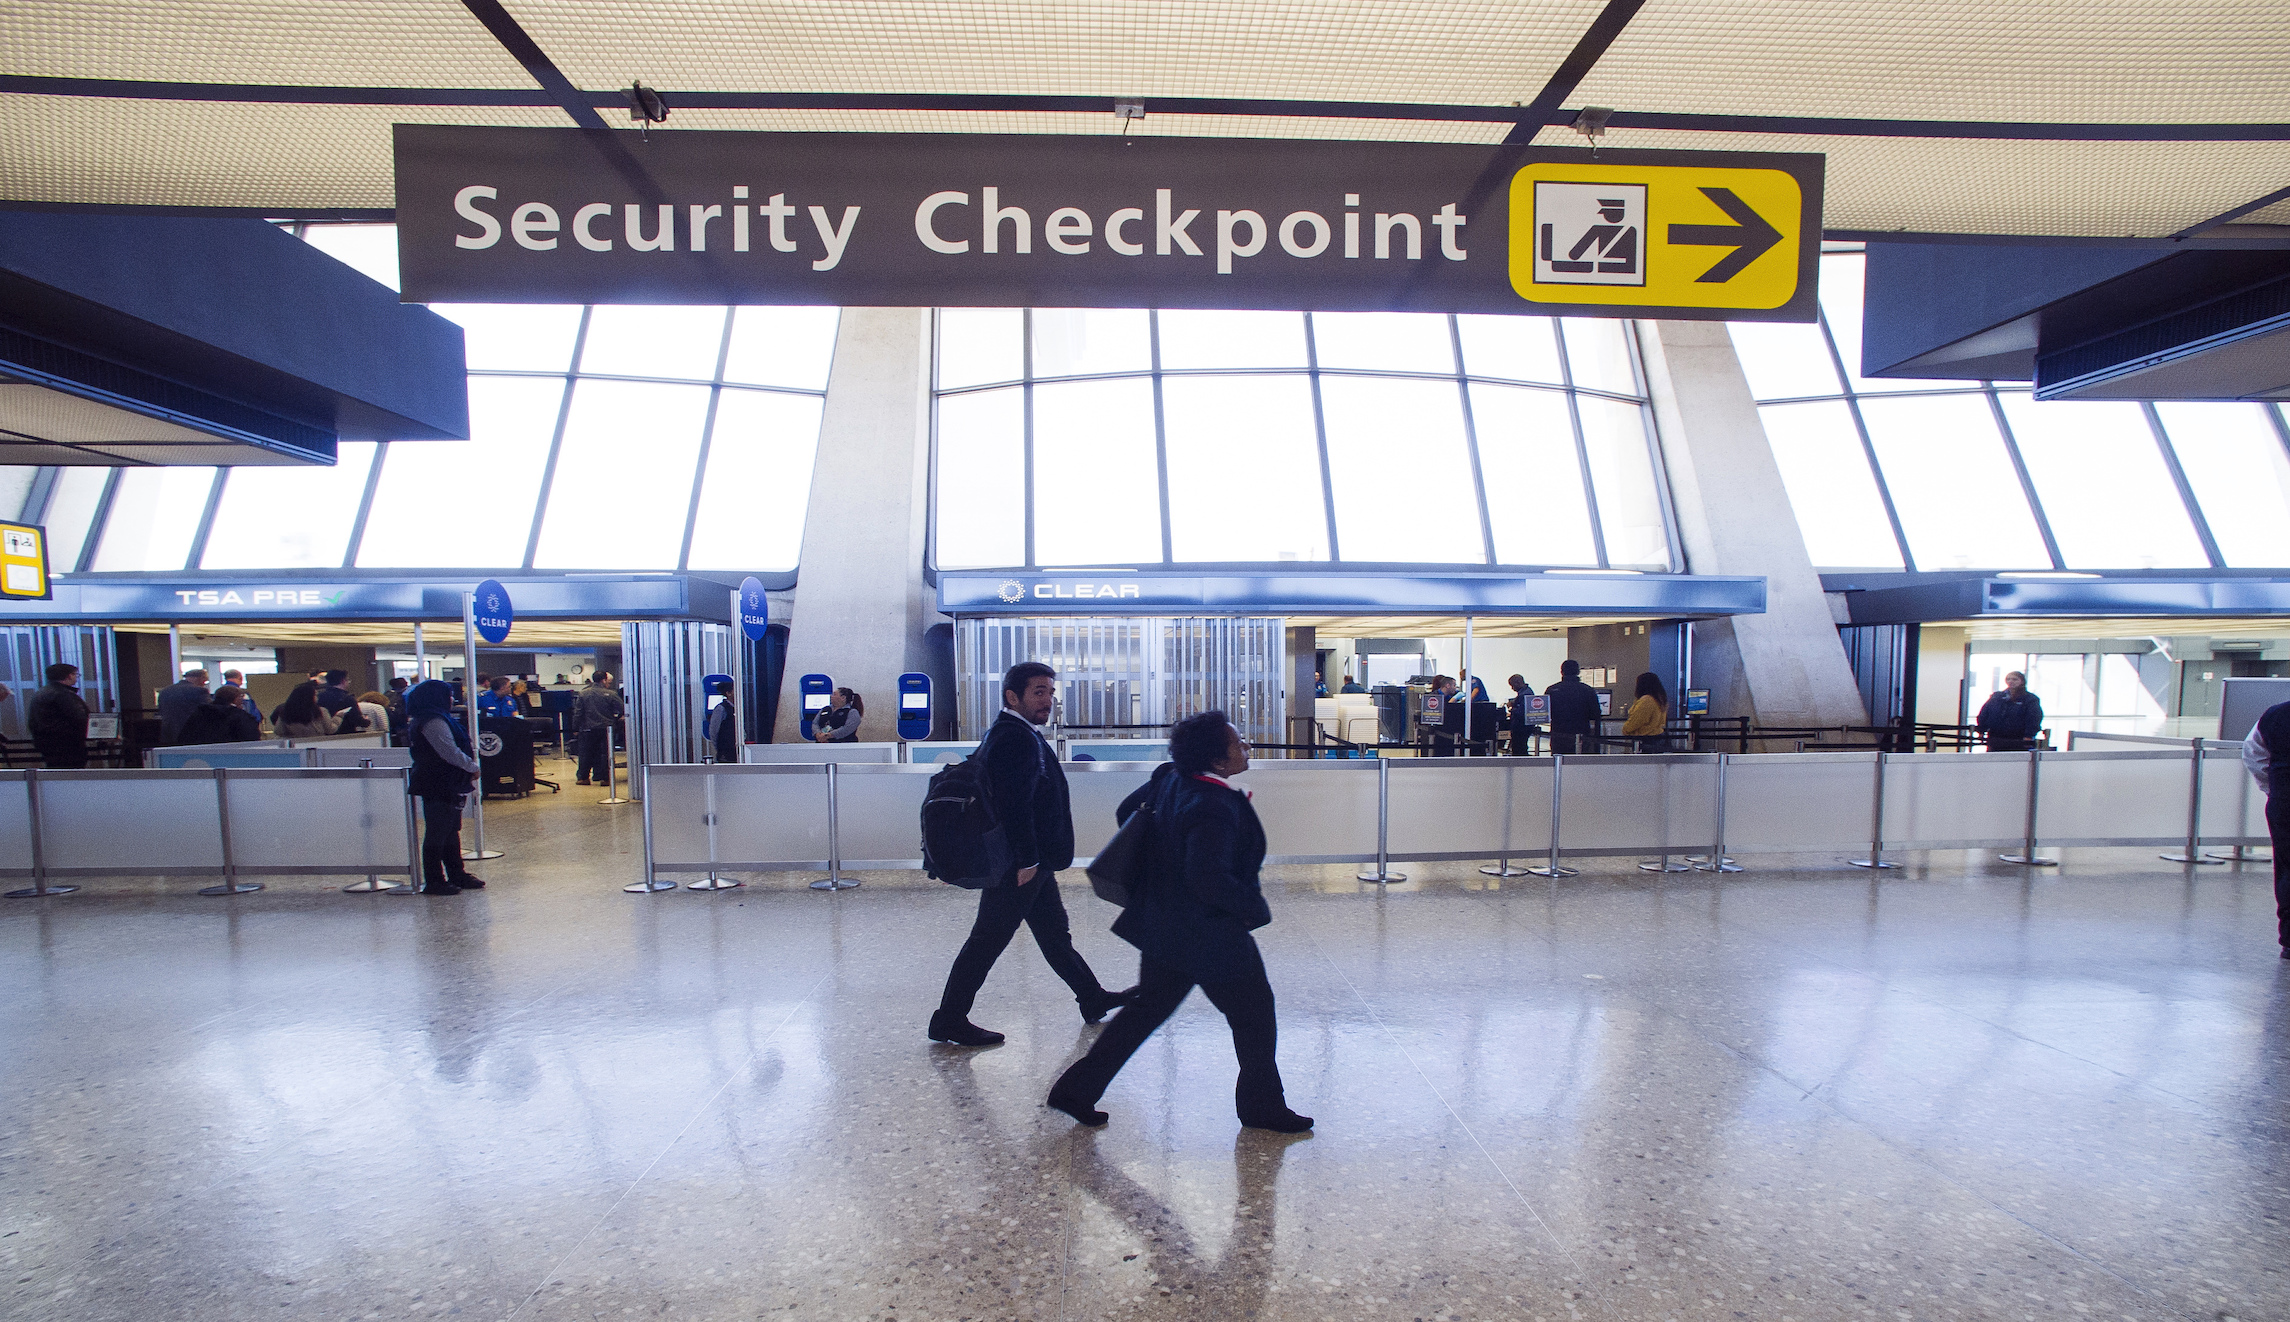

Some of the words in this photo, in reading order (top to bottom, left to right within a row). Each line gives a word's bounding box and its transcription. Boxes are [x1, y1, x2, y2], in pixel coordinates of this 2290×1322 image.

[453, 185, 861, 272] Security
[914, 186, 1468, 275] Checkpoint
[175, 590, 245, 605] TSA
[253, 590, 321, 605] PRE
[1034, 584, 1140, 598] CLEAR
[480, 617, 508, 628] CLEAR
[744, 614, 765, 626] CLEAR
